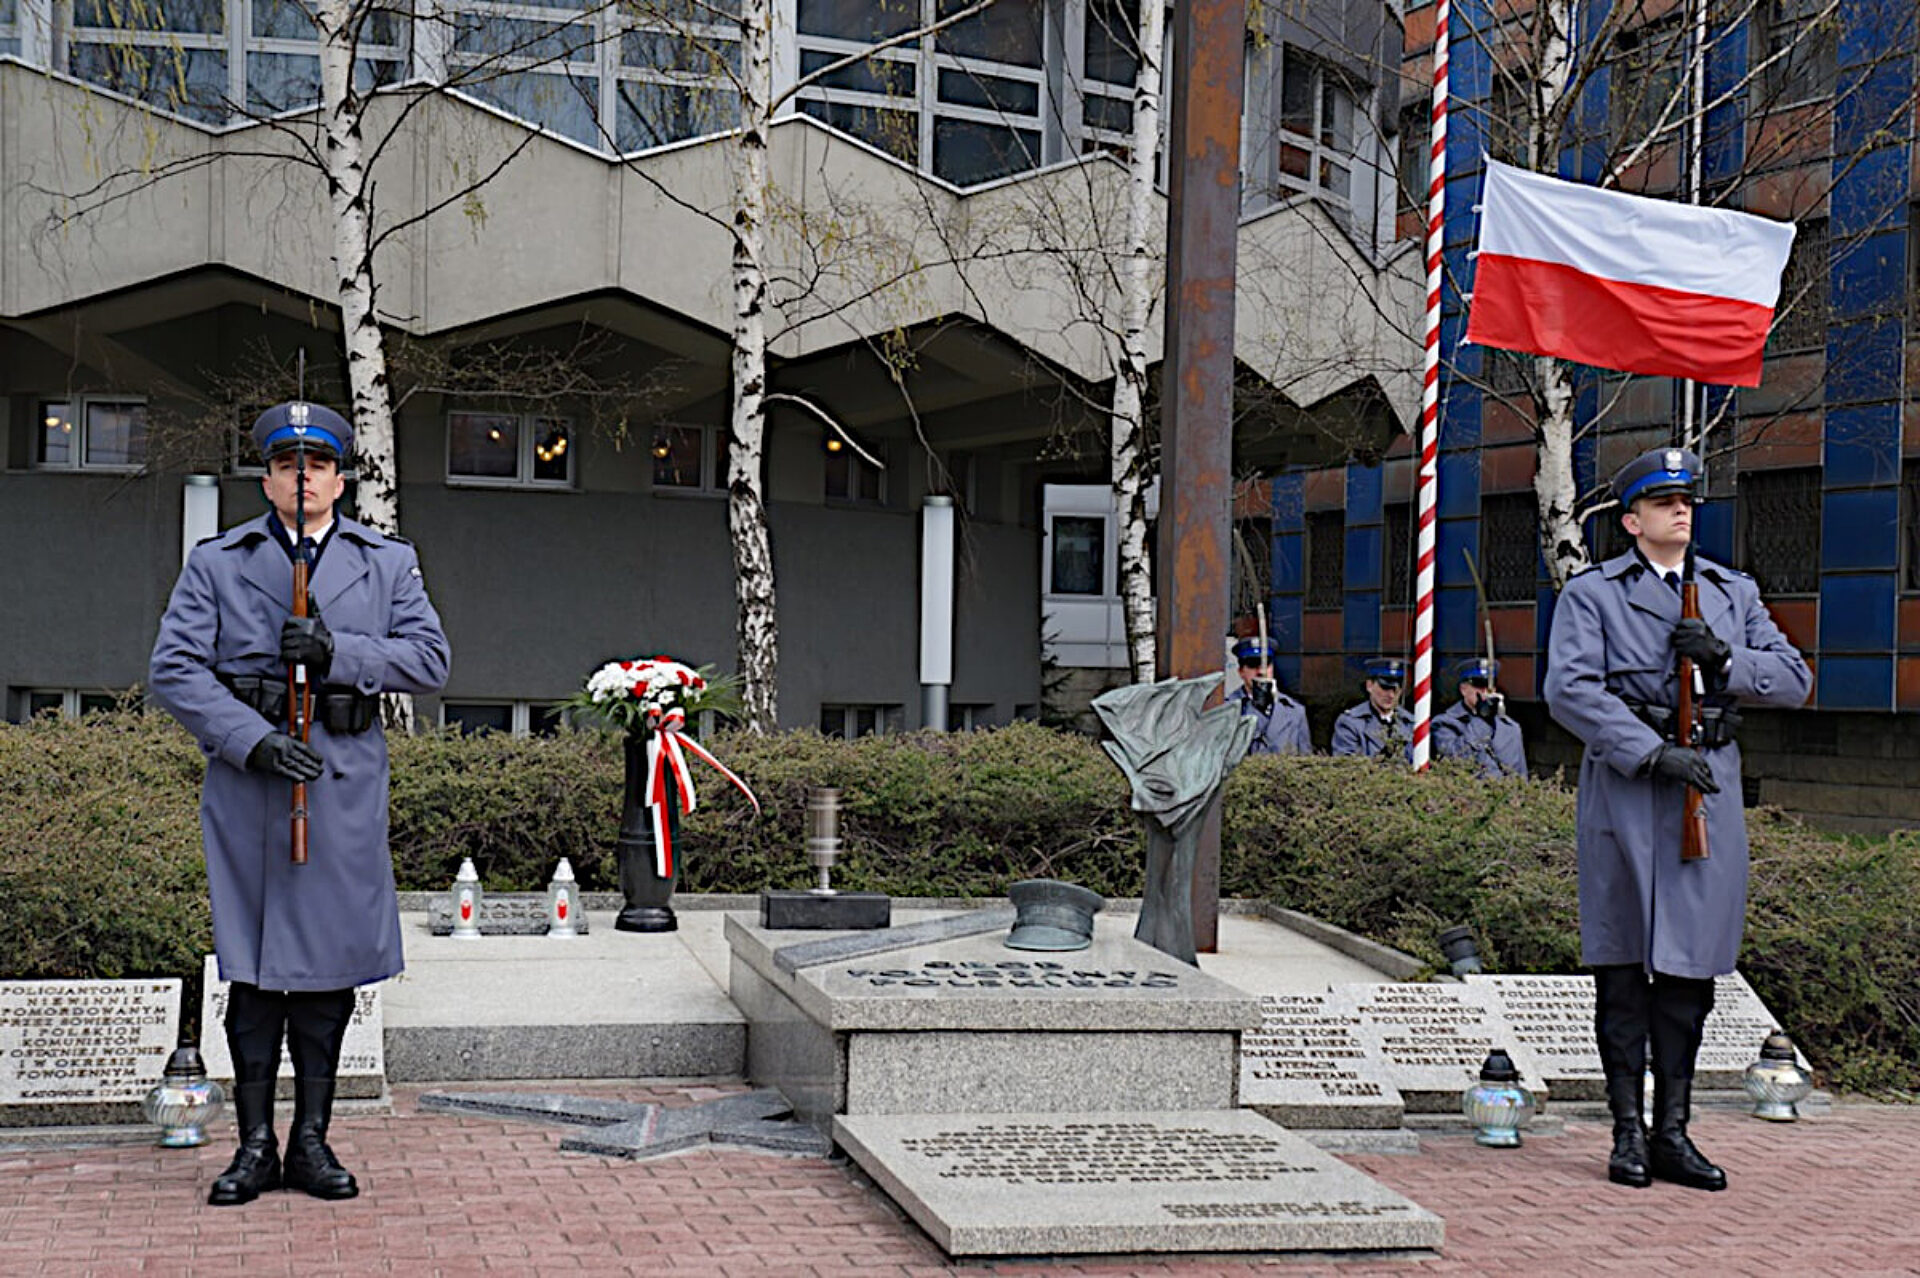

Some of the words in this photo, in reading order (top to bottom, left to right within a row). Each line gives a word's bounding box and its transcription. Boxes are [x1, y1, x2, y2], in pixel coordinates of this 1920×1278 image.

[1, 986, 127, 996] POLICJANTOM
[133, 985, 145, 995] II
[1378, 985, 1444, 996] PAMIĘCI
[27, 996, 143, 1007] NIEWINNIE
[1374, 995, 1420, 1004] MATEK
[2, 1006, 167, 1018] POMORDOWANYM
[1357, 1005, 1488, 1015] POMORDOWANYCH
[1371, 1016, 1482, 1025] POLICJANTÓW
[22, 1036, 140, 1048] KOMUNISTÓW
[1381, 1046, 1449, 1057] POWROTU
[16, 1068, 137, 1080] POWOJENNYM
[1252, 1070, 1358, 1081] KAZACHSTANU
